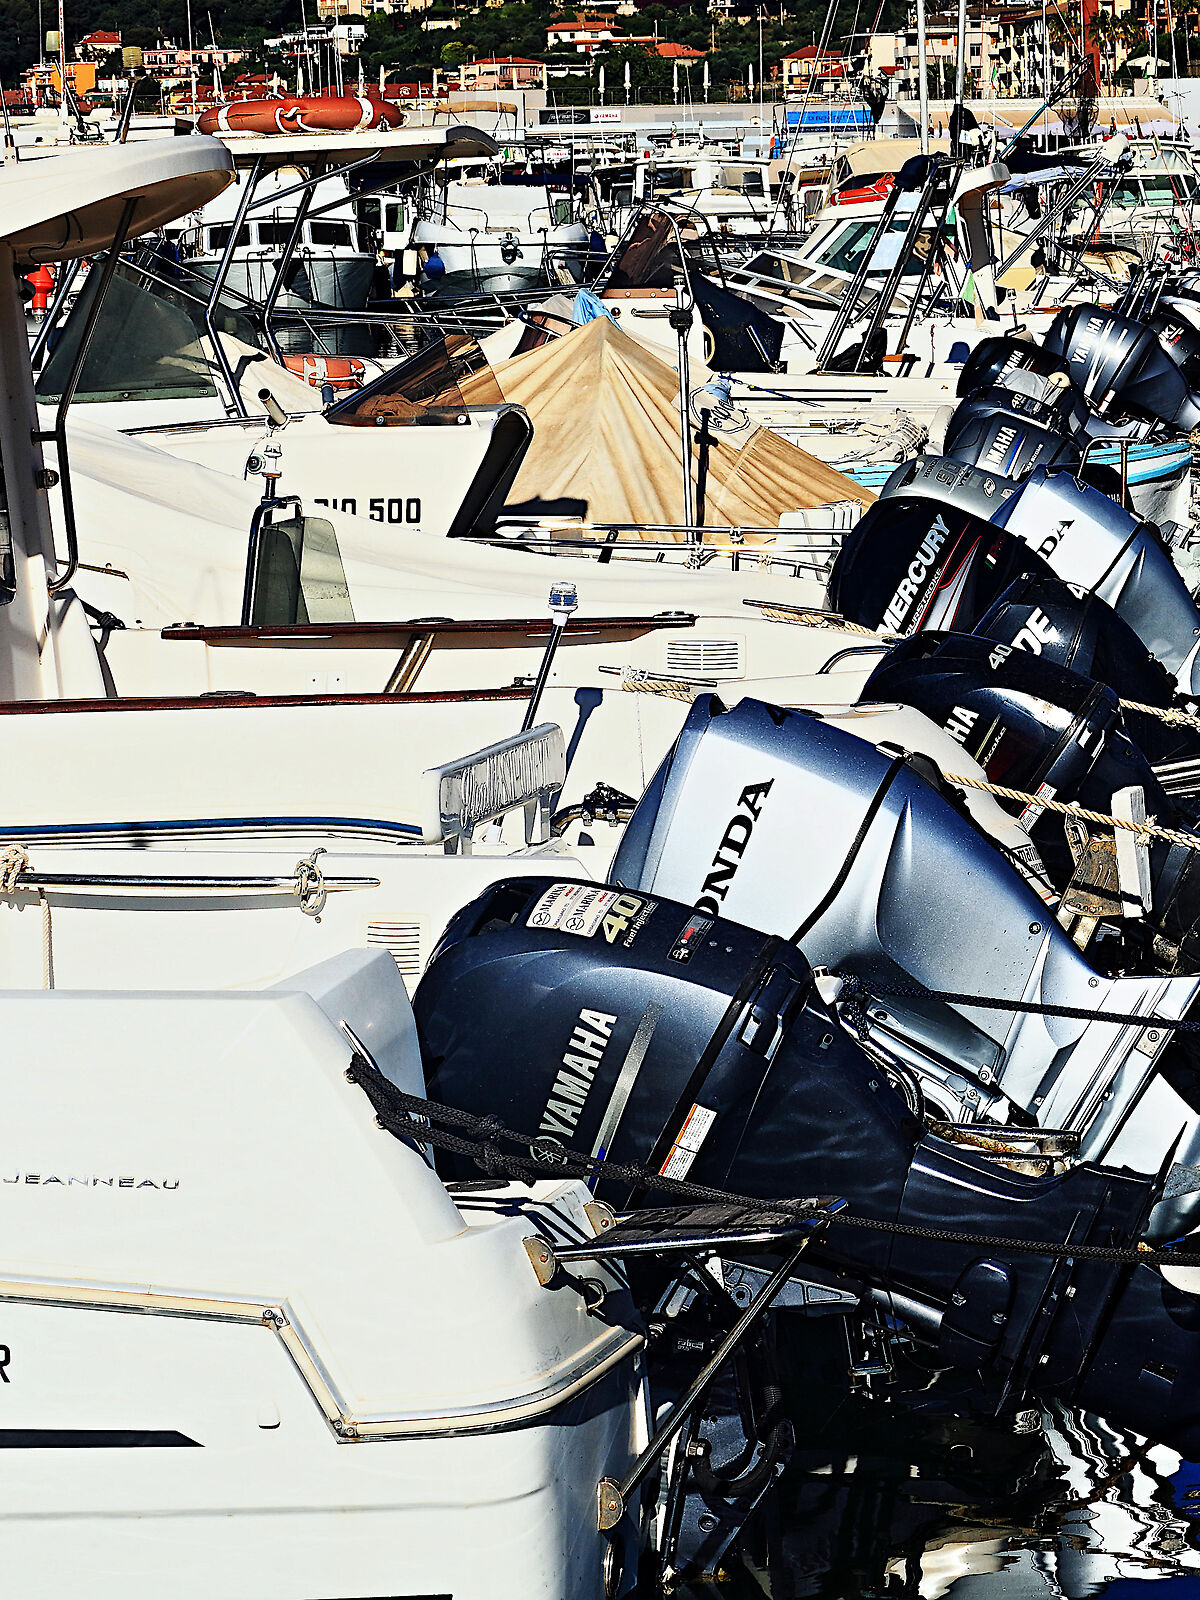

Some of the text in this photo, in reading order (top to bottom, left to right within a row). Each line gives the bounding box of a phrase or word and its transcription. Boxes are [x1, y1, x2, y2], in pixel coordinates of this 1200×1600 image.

[368, 497, 421, 524] 500
[904, 567, 946, 638] OURSTROKE
[988, 643, 1014, 670] 40
[539, 885, 568, 914] MARINA
[573, 889, 602, 919] MARINA
[602, 893, 642, 944] 40
[623, 931, 638, 948] Fuel
[539, 1007, 619, 1138] YAMAHA
[3, 1168, 180, 1190] JEANNEAU
